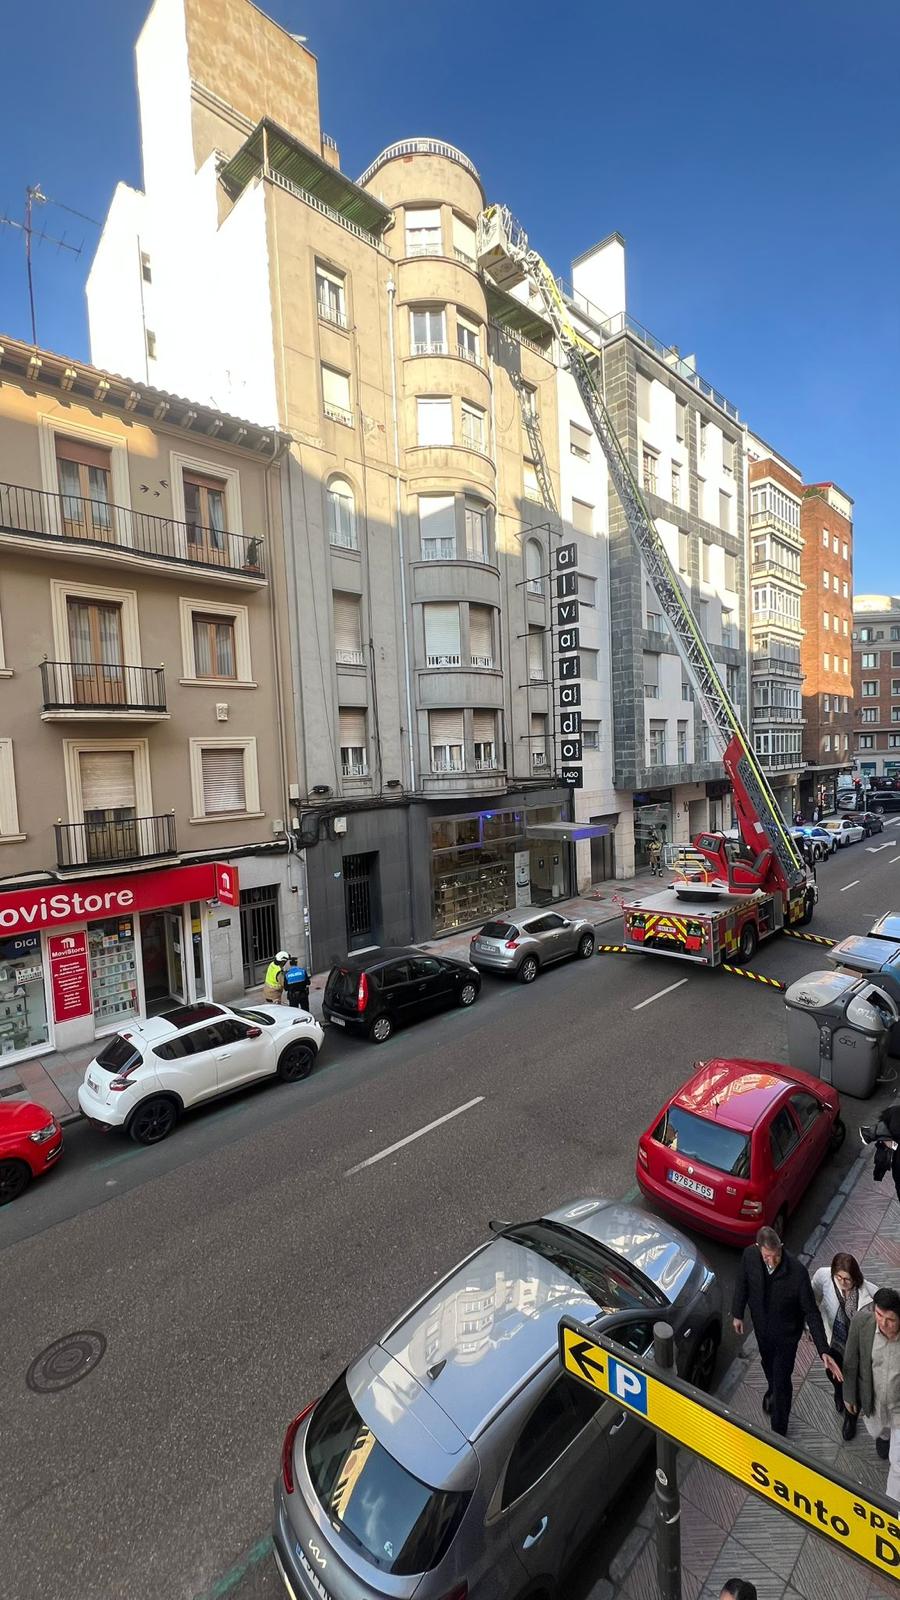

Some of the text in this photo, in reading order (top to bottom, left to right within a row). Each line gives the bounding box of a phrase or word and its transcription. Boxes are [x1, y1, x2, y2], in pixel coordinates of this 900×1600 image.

[563, 771, 579, 779] LAGO
[0, 889, 134, 927] oviStore
[14, 938, 37, 949] DIGI
[52, 946, 85, 958] MoviStore
[674, 1172, 694, 1188] 9762
[695, 1183, 712, 1198] FGS
[615, 1363, 642, 1399] P
[750, 1461, 850, 1537] Santo
